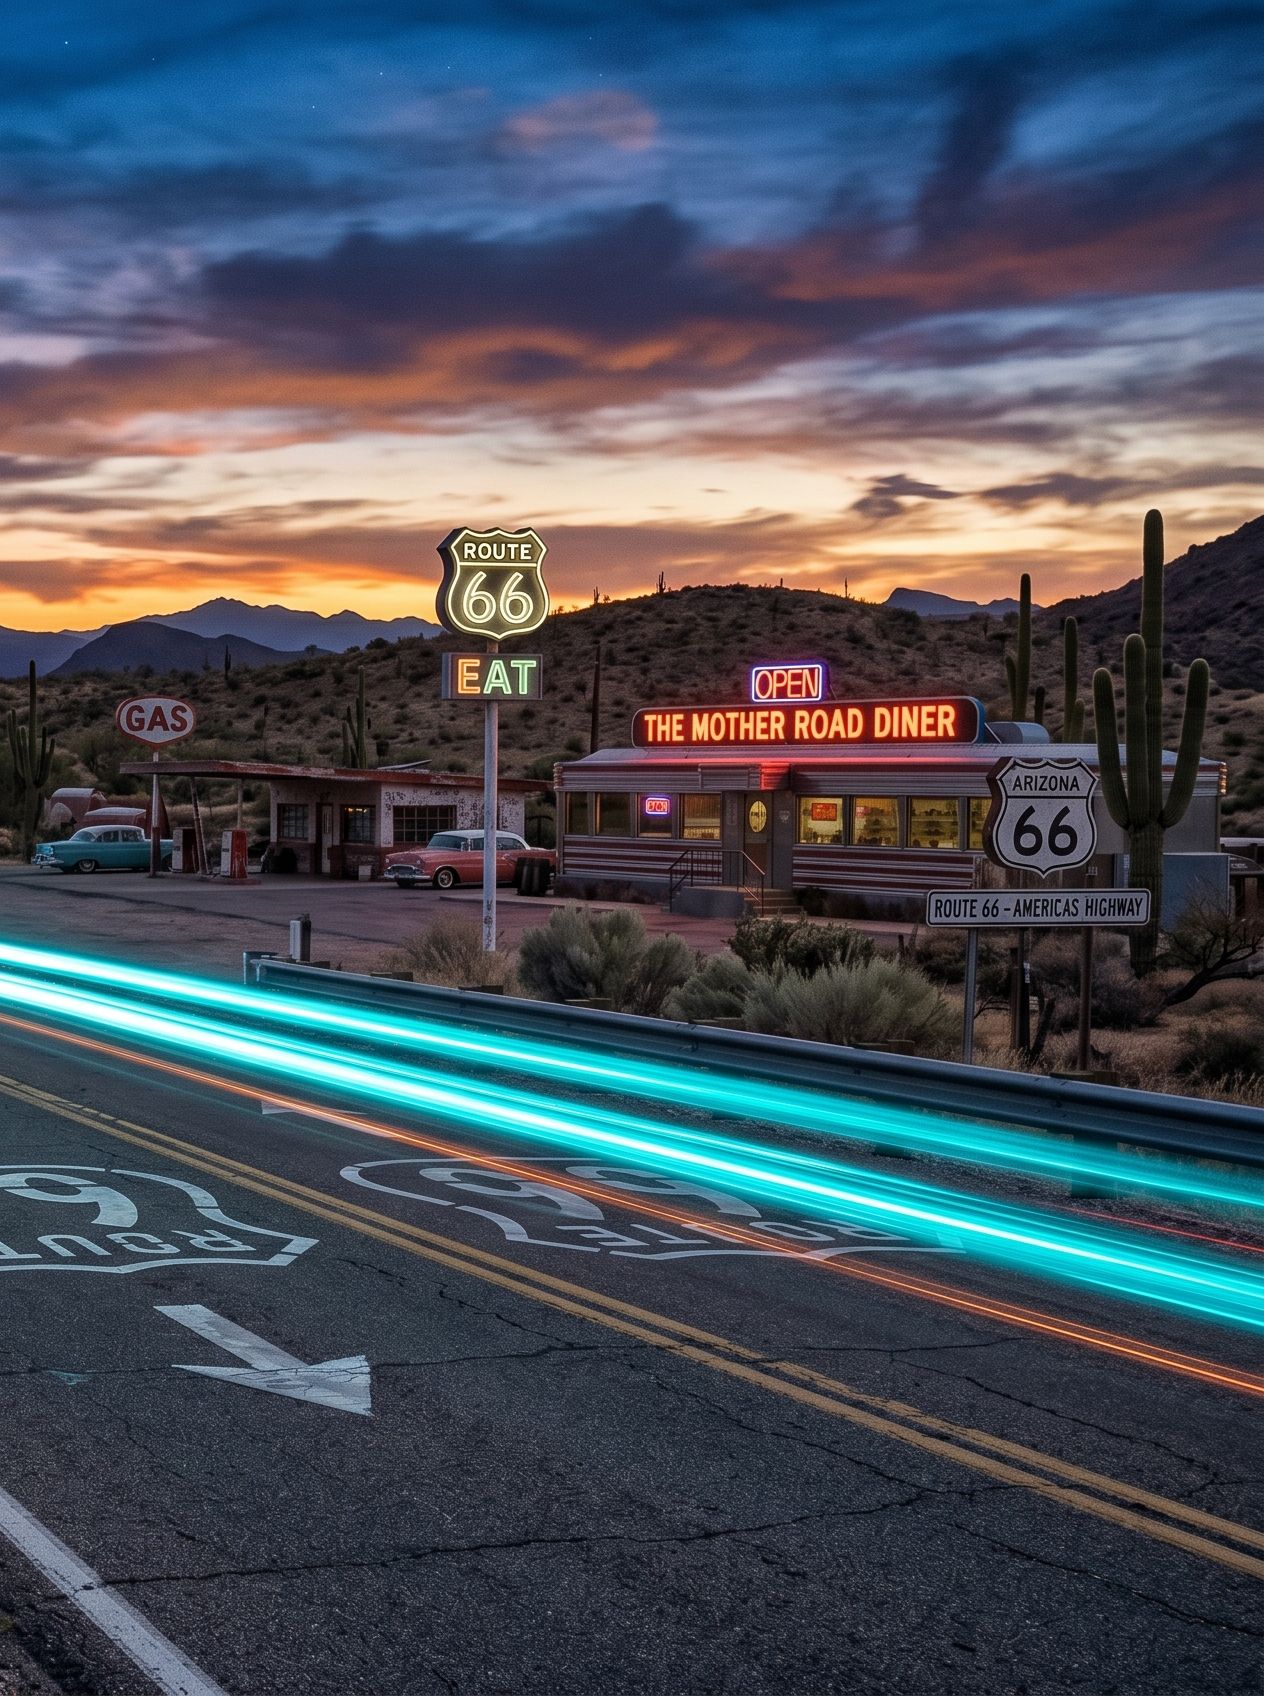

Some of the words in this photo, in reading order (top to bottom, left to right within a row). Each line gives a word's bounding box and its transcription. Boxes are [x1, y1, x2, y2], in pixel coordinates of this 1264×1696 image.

[463, 542, 532, 560] ROUTE
[463, 571, 533, 624] 66
[458, 658, 537, 694] EAT
[755, 668, 819, 699] OPEN
[126, 704, 188, 732] GAS
[644, 714, 684, 742] THE
[692, 710, 785, 741] MOTHER
[794, 707, 863, 740] ROAD
[874, 704, 955, 738] DINER
[1012, 775, 1080, 792] ARIZONA
[1013, 805, 1078, 857] 66
[934, 899, 977, 918] ROUTE
[981, 899, 999, 918] 66
[1012, 898, 1079, 918] AMERICAS
[1085, 897, 1143, 917] HIGHWAY
